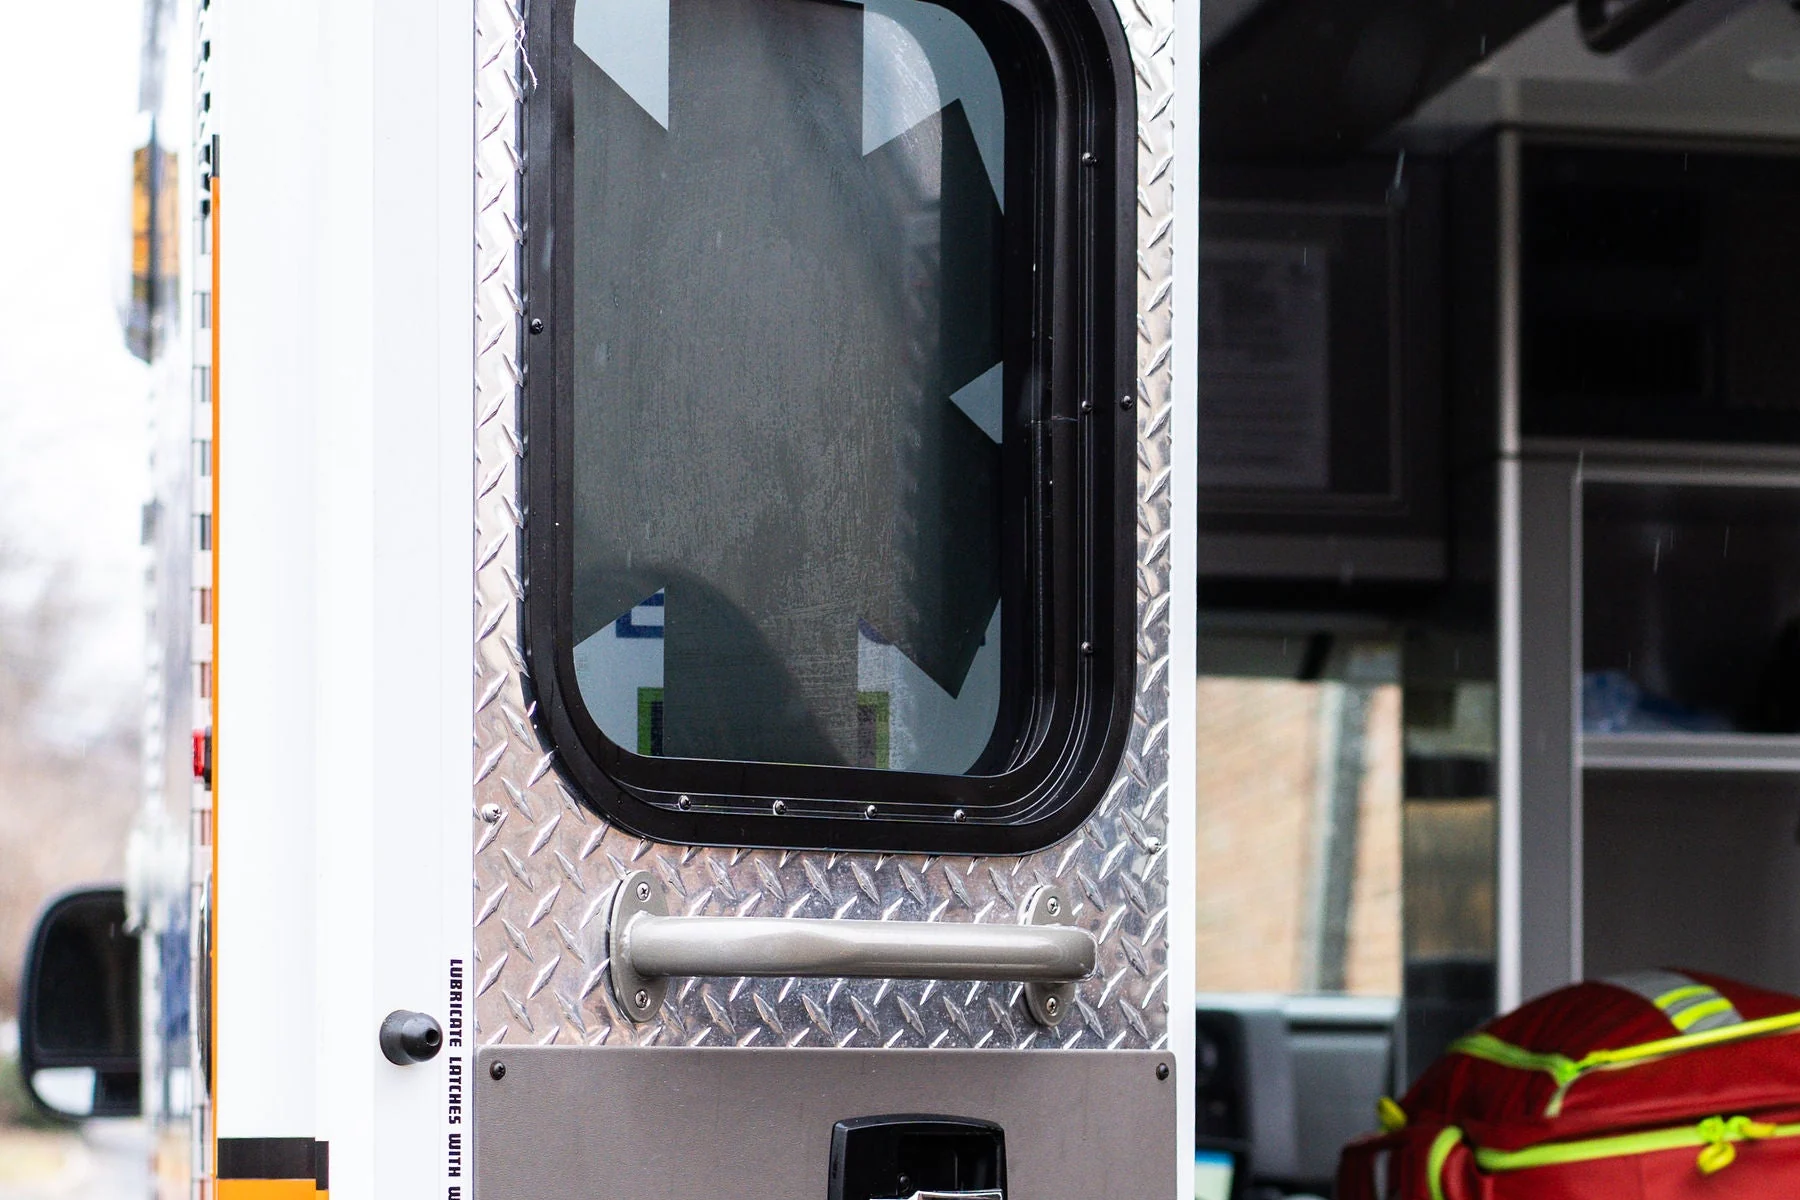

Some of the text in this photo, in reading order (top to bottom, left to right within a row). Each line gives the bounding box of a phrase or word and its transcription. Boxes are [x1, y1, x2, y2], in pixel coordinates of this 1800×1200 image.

[449, 959, 463, 1047] LUBRICATE
[448, 1057, 462, 1124] LATCHES
[448, 1134, 461, 1177] WITH
